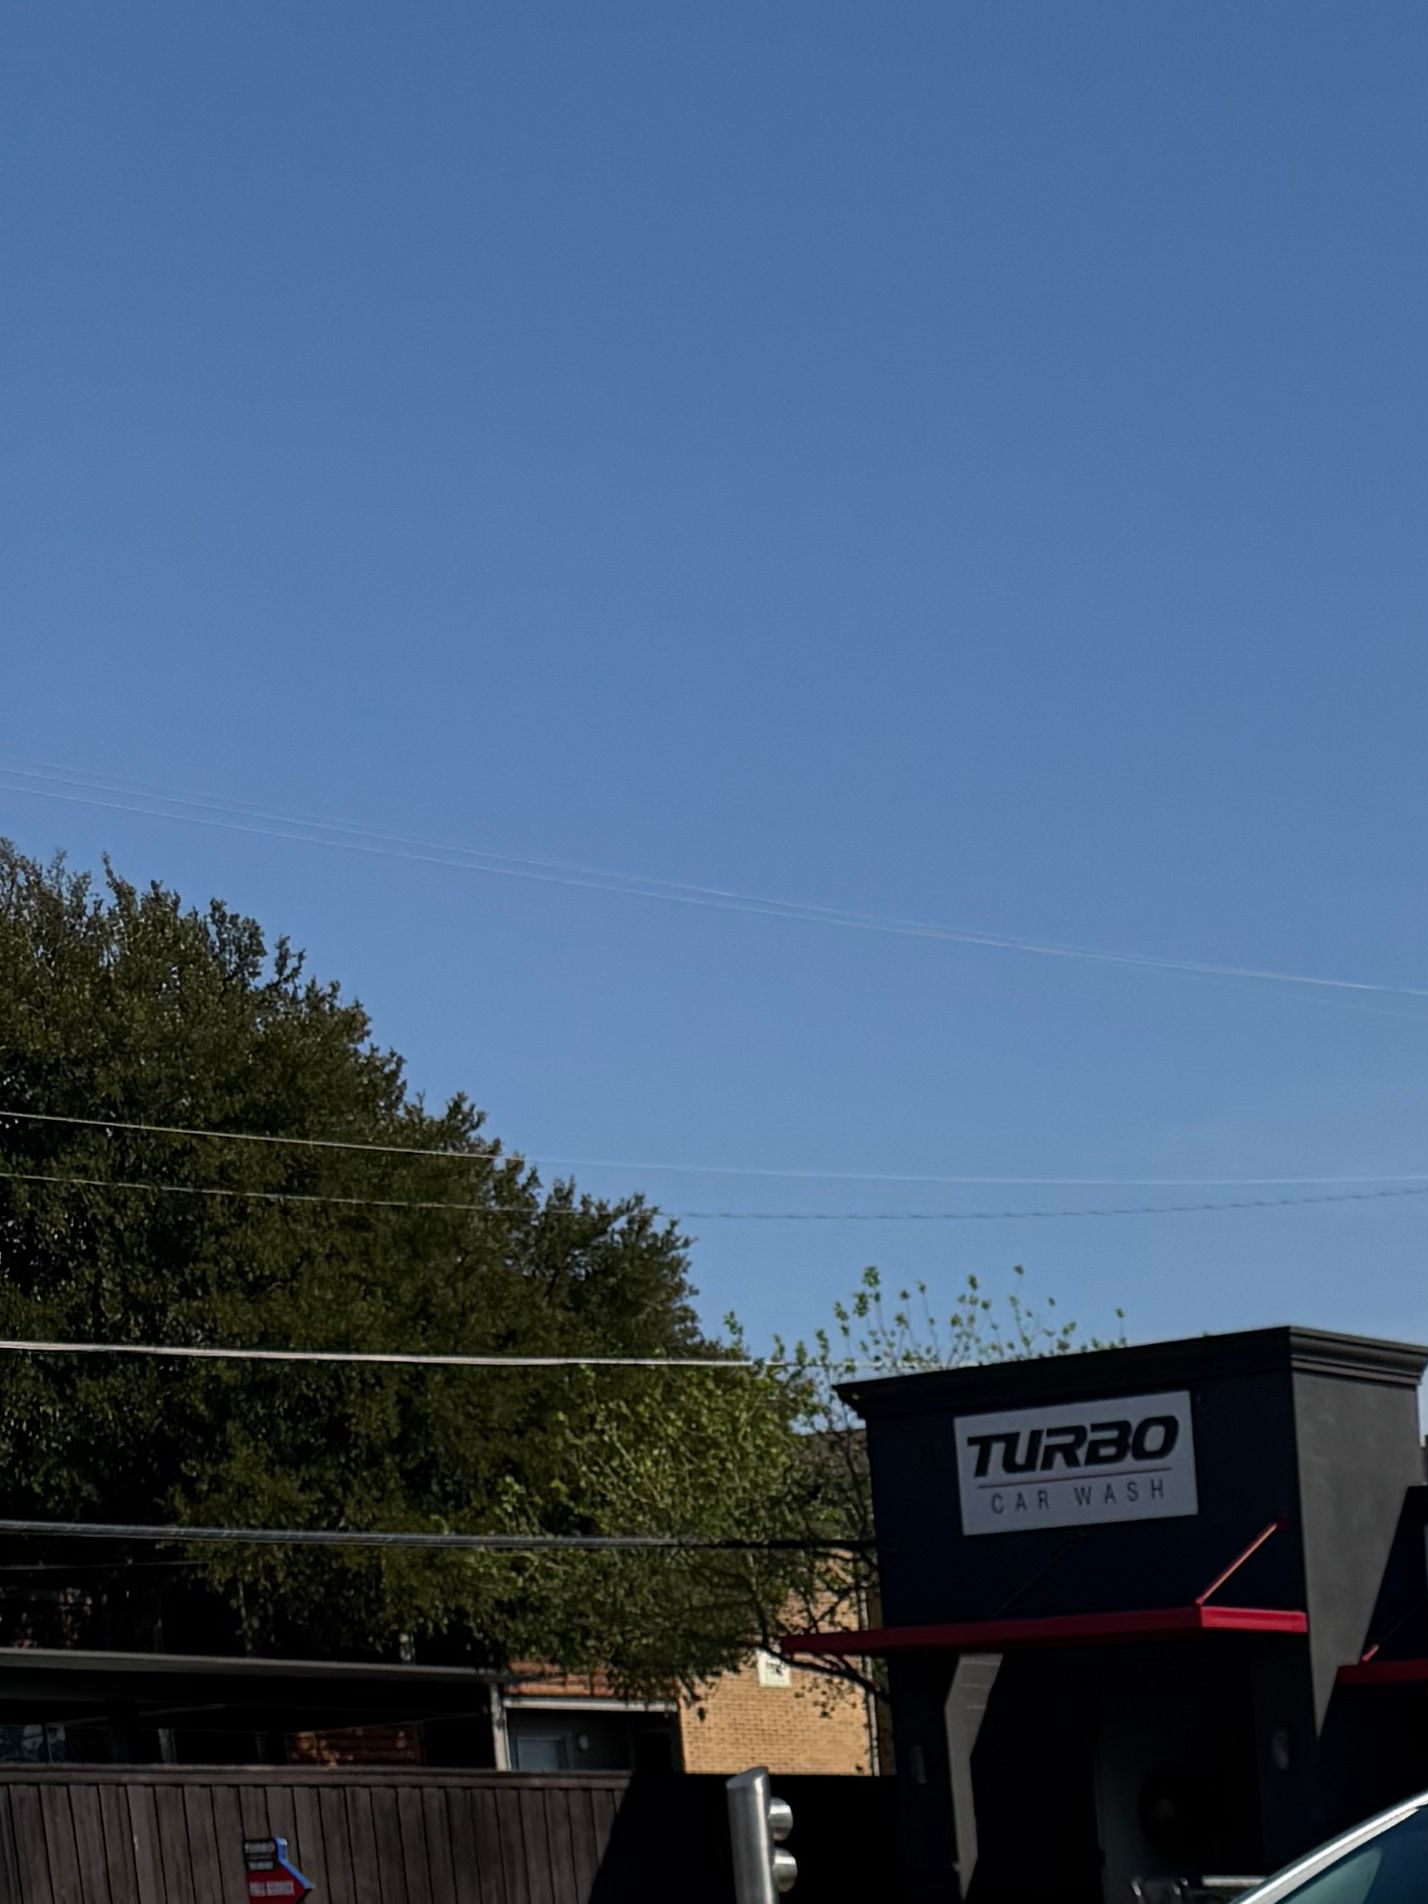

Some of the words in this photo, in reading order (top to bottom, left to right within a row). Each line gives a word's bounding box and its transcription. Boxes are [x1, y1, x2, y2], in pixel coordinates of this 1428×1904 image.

[967, 1415, 1179, 1478] TURBO
[991, 1490, 1049, 1514] CAR
[1074, 1479, 1165, 1507] WASH
